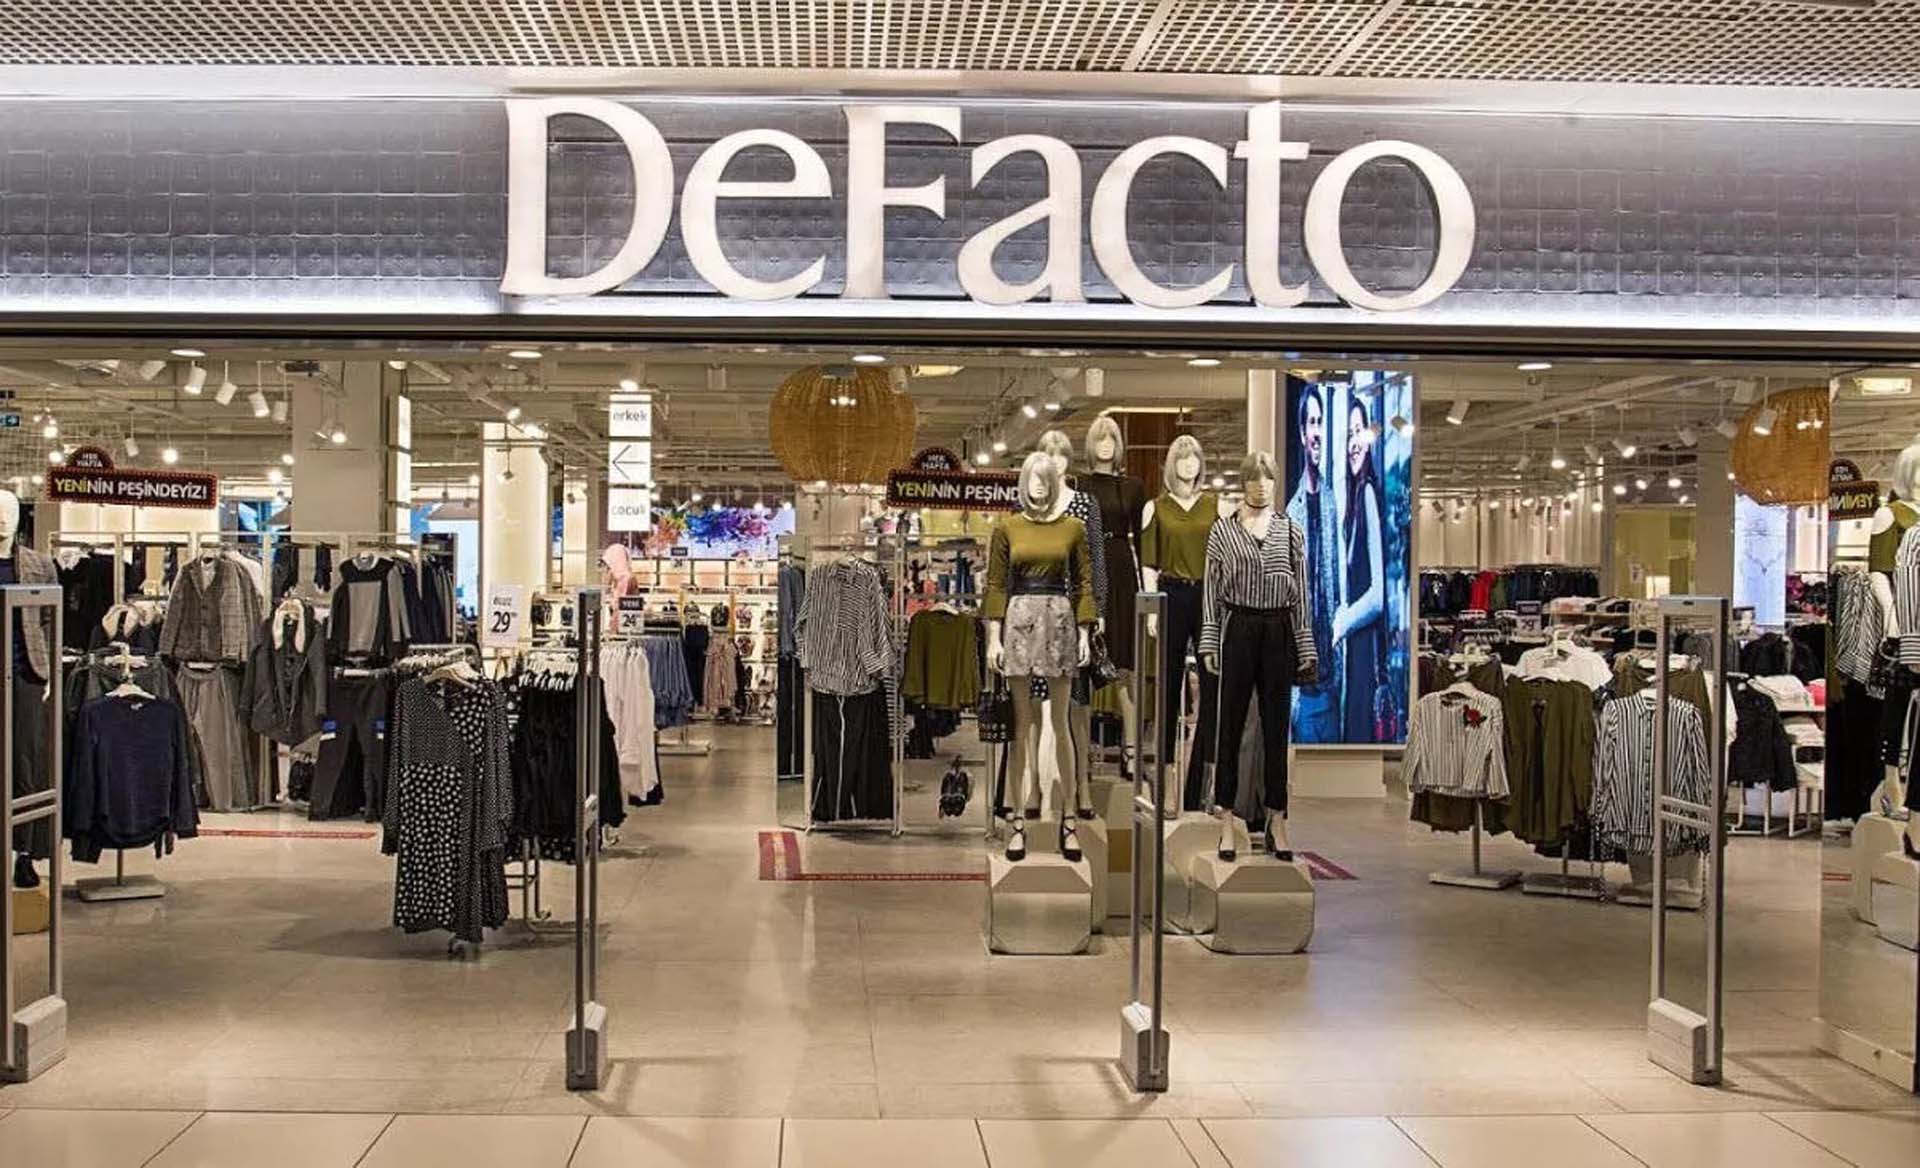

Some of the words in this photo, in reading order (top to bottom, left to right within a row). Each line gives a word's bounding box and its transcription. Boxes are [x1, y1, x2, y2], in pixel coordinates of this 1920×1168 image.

[500, 97, 1476, 311] DeFacto
[55, 476, 114, 495] YENİNİN
[118, 479, 207, 499] PEŞİNDEYİZ!
[896, 480, 960, 499] YENİNİN
[965, 482, 1020, 504] PEŞİND
[491, 611, 511, 633] 29
